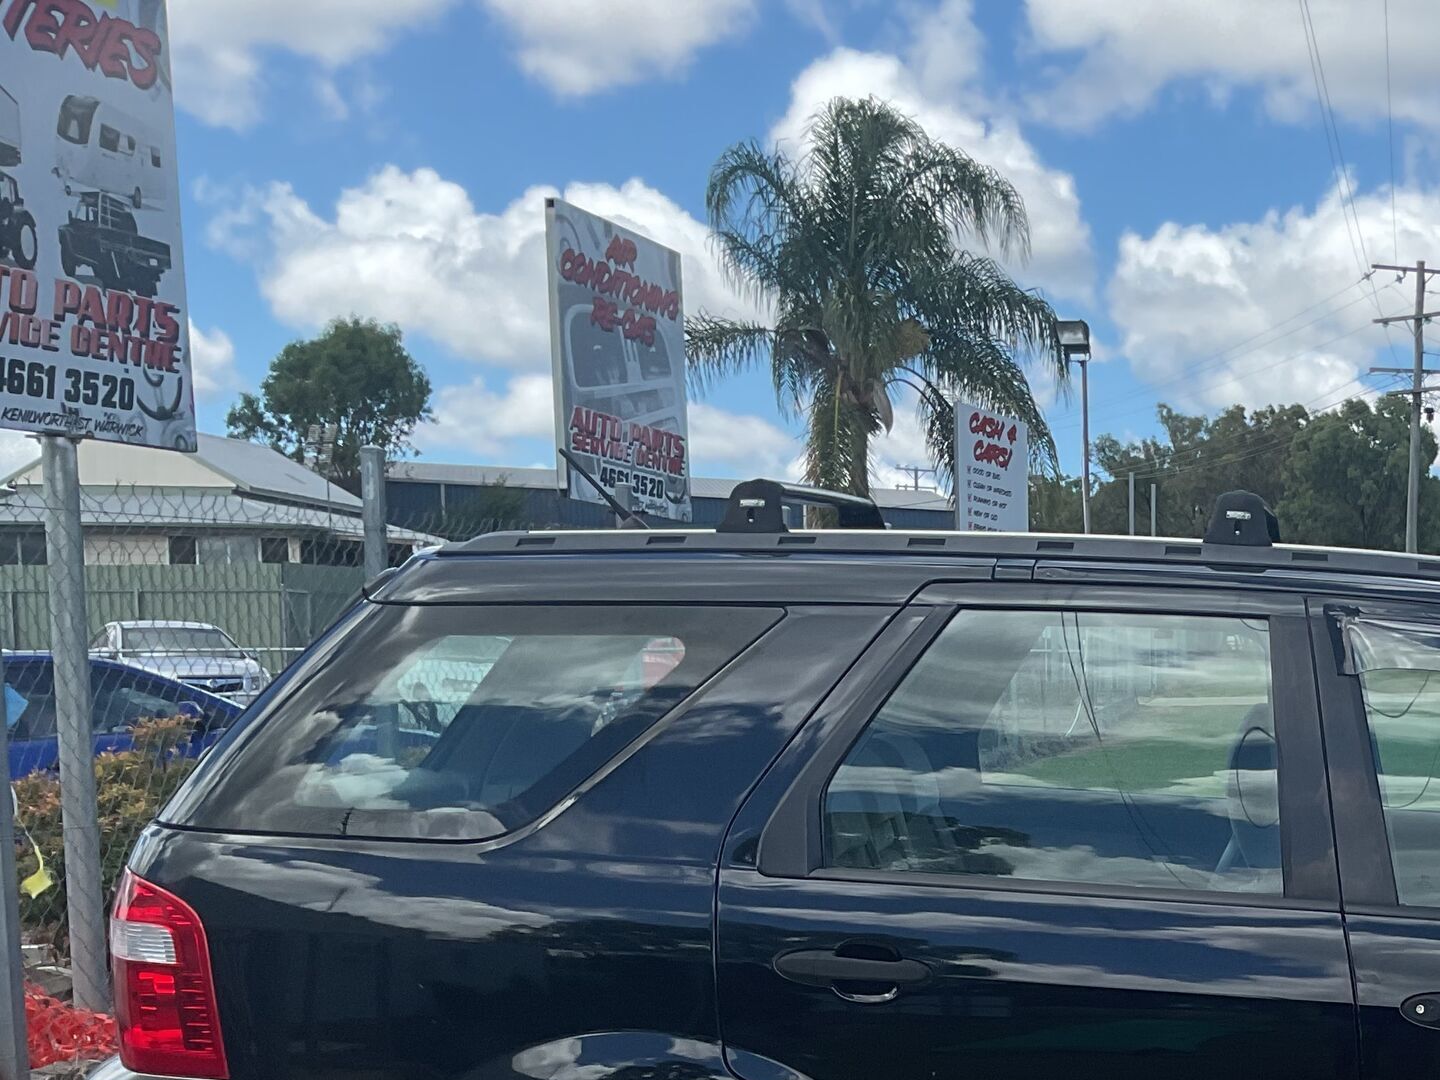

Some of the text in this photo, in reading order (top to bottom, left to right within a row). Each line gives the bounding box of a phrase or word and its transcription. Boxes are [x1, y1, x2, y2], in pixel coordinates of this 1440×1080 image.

[605, 234, 637, 273] AIR
[561, 248, 679, 322] CONDITIONING
[54, 279, 180, 344] PARTS
[71, 325, 181, 374] CENTRE
[64, 368, 135, 410] 3520
[94, 419, 144, 437] WARWICK
[570, 406, 685, 459] AUTO PARTS
[969, 412, 1005, 441] CASH
[572, 432, 685, 477] SERVICE CENTRE
[632, 474, 664, 499] 3520
